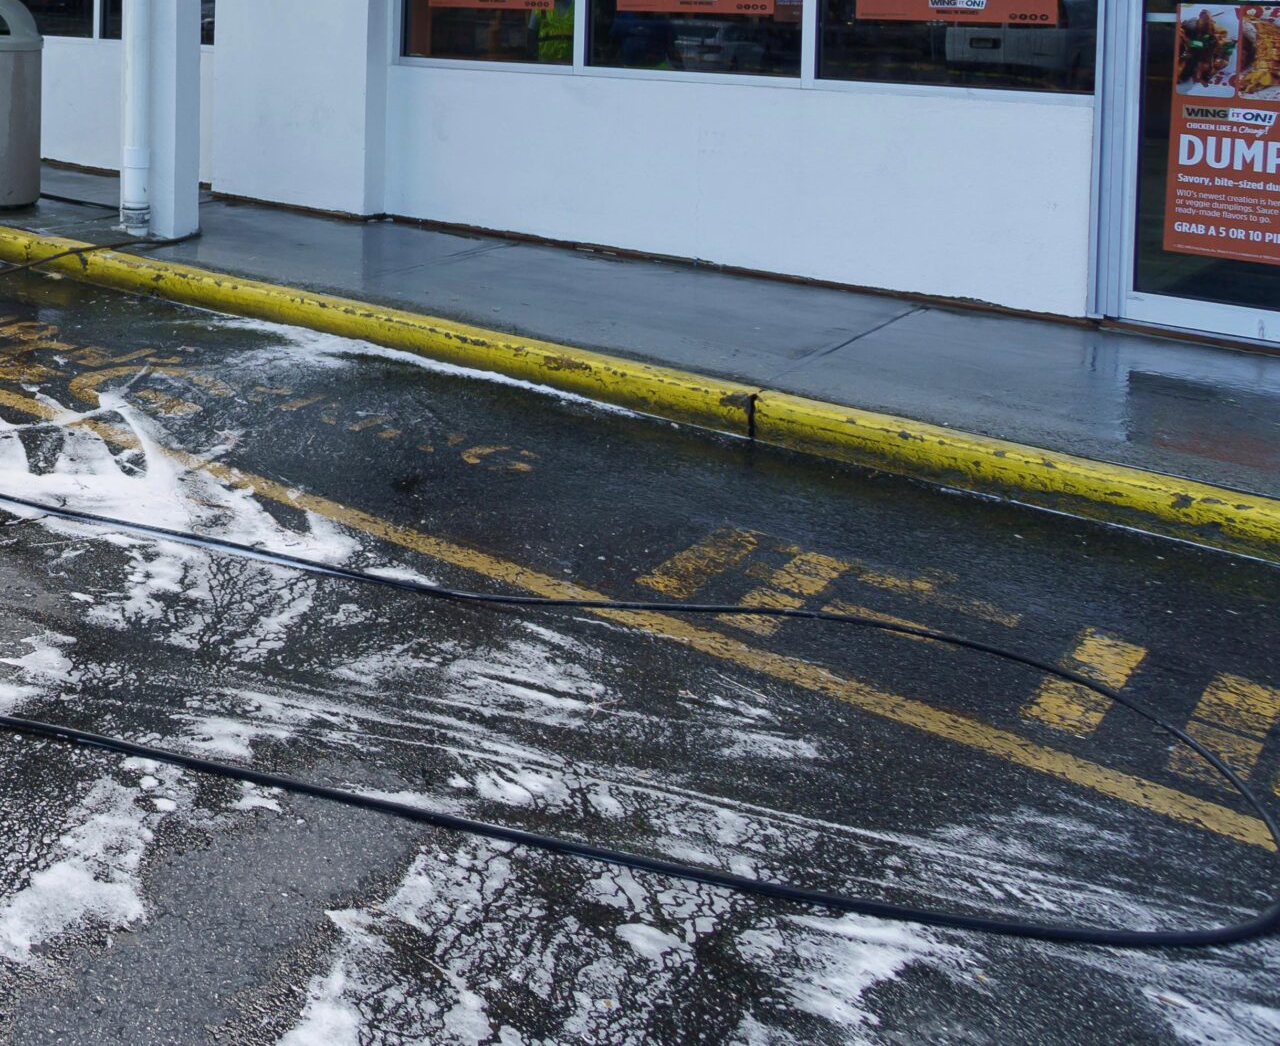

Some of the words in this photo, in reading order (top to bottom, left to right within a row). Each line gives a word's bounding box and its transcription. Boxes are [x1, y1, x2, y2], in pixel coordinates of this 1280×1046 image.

[965, 0, 984, 8] ON!
[1185, 107, 1228, 119] WING
[1242, 112, 1273, 124] ON!
[1186, 122, 1215, 131] CHICKEN
[1216, 124, 1231, 132] LIKE
[1177, 173, 1212, 186] Savory,
[1214, 177, 1264, 190] bite-sized
[1199, 192, 1225, 201] newest
[1227, 195, 1258, 204] creation
[1175, 207, 1220, 218] ready-made
[1222, 211, 1248, 221] flavors
[1249, 214, 1257, 222] to
[1259, 216, 1272, 224] go.
[1185, 200, 1210, 208] veggie
[1212, 202, 1254, 214] dumplings.
[1256, 206, 1279, 216] Sauce
[1174, 221, 1205, 234] GRAB
[1208, 225, 1216, 236] A
[1219, 227, 1226, 237] 5
[1229, 228, 1246, 240] OR
[1248, 231, 1262, 242] 10
